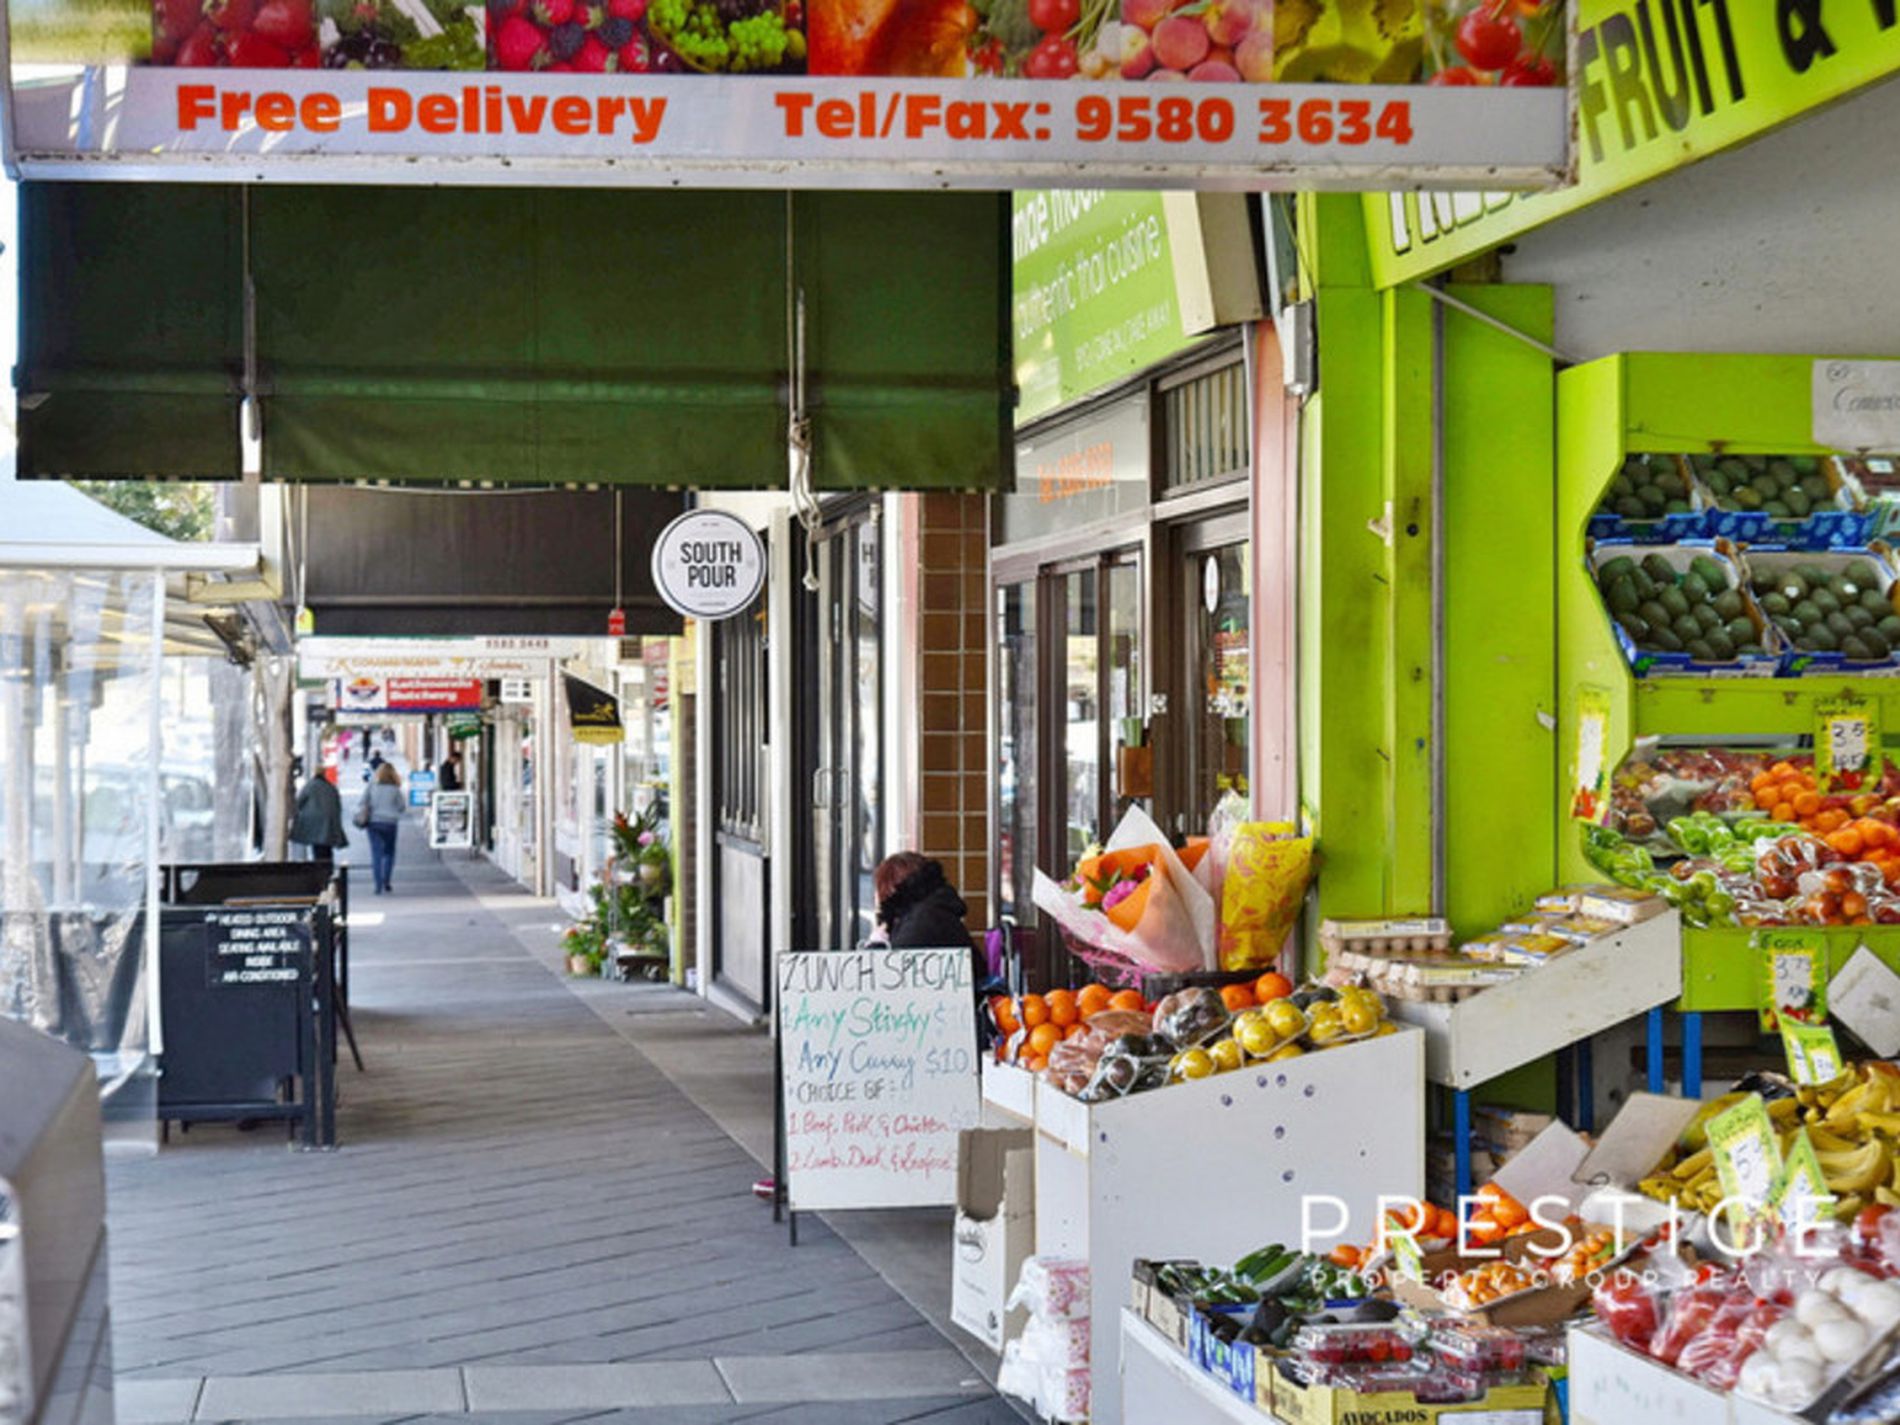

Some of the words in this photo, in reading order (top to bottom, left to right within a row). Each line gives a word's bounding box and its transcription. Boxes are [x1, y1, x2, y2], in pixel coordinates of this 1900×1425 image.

[176, 84, 341, 132] Free
[366, 85, 668, 144] Delivery
[775, 91, 1051, 140] Tel/Fax:
[1074, 95, 1236, 144] 9580
[1257, 98, 1414, 146] 3634
[680, 541, 742, 564] SOUTH
[687, 565, 737, 588] POUR
[881, 949, 970, 992] SPECIAL
[794, 995, 847, 1047] Any
[799, 1040, 843, 1081] Any
[926, 1047, 970, 1077] $10
[797, 1080, 856, 1102] CHOICE
[1340, 1409, 1428, 1425] AVOCADOS
